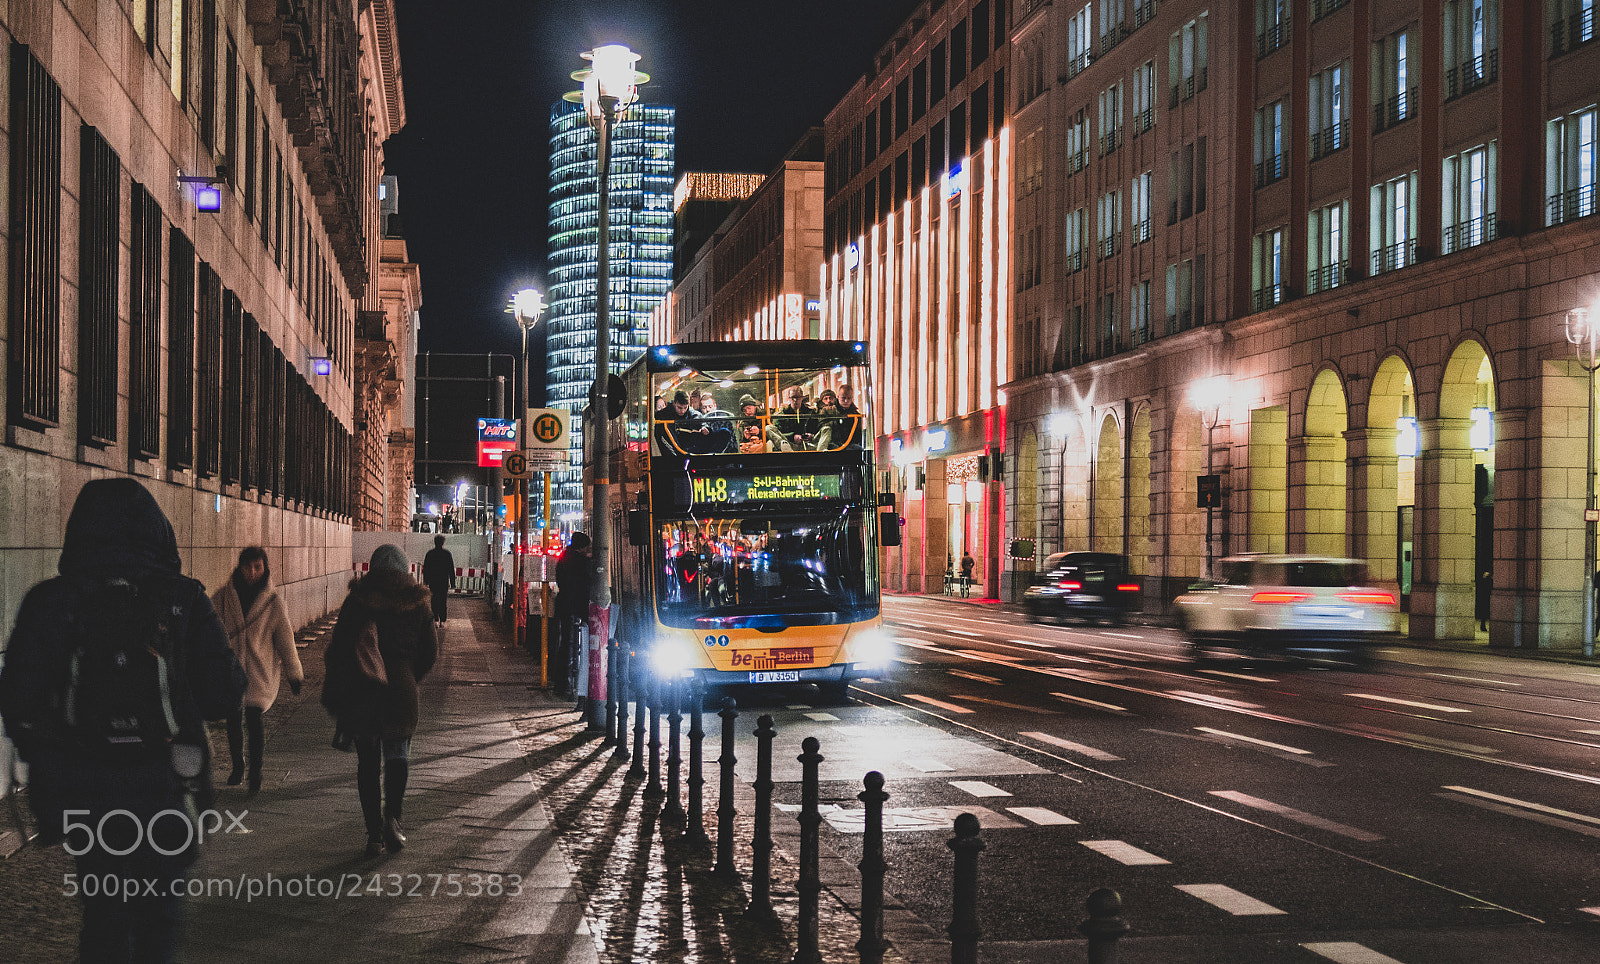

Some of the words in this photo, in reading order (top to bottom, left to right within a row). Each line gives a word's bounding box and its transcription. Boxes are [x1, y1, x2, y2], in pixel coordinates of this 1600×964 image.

[484, 426, 511, 436] HIT
[540, 420, 555, 437] H
[753, 475, 815, 488] S+U-Bahnhof
[693, 477, 727, 503] M48
[747, 487, 820, 500] Alexanderplatz
[731, 649, 753, 666] be
[778, 651, 810, 662] Berlin
